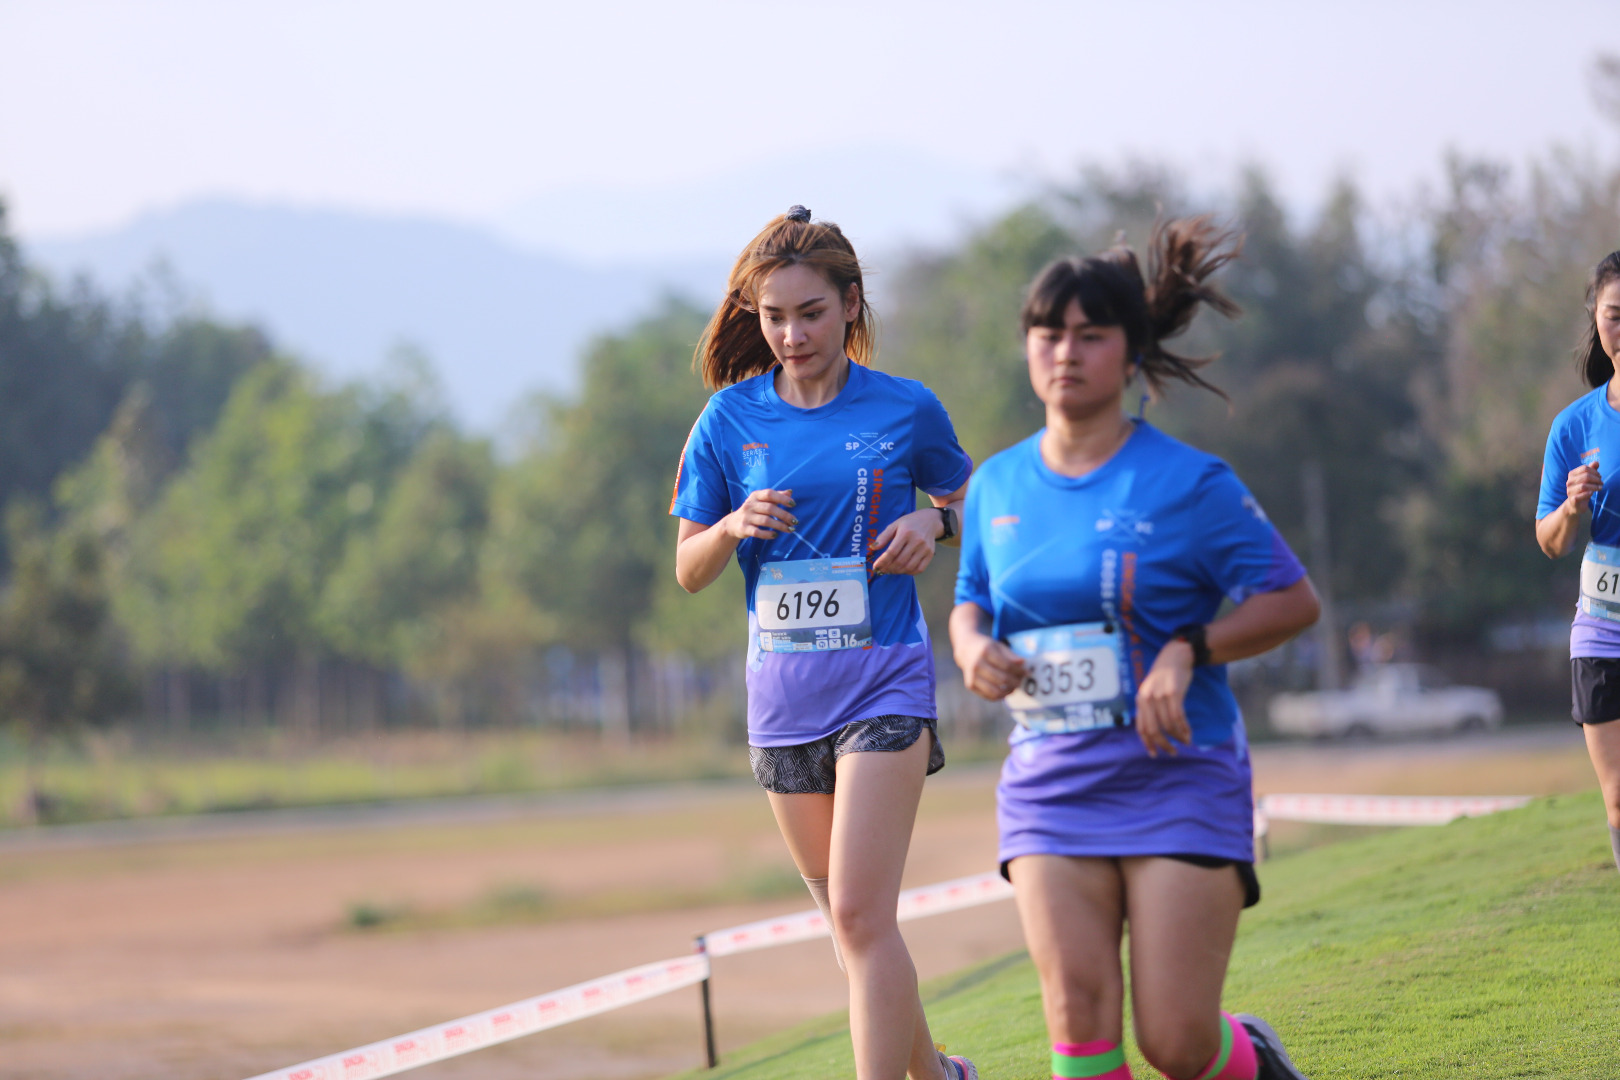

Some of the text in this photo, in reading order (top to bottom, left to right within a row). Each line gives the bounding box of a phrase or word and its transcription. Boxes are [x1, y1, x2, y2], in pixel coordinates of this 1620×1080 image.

[845, 441, 895, 451] SP XC
[856, 467, 868, 512] CROSS
[868, 468, 884, 525] SINGHA
[776, 588, 840, 621] 6196
[842, 633, 858, 649] 16
[1023, 658, 1095, 697] 6353
